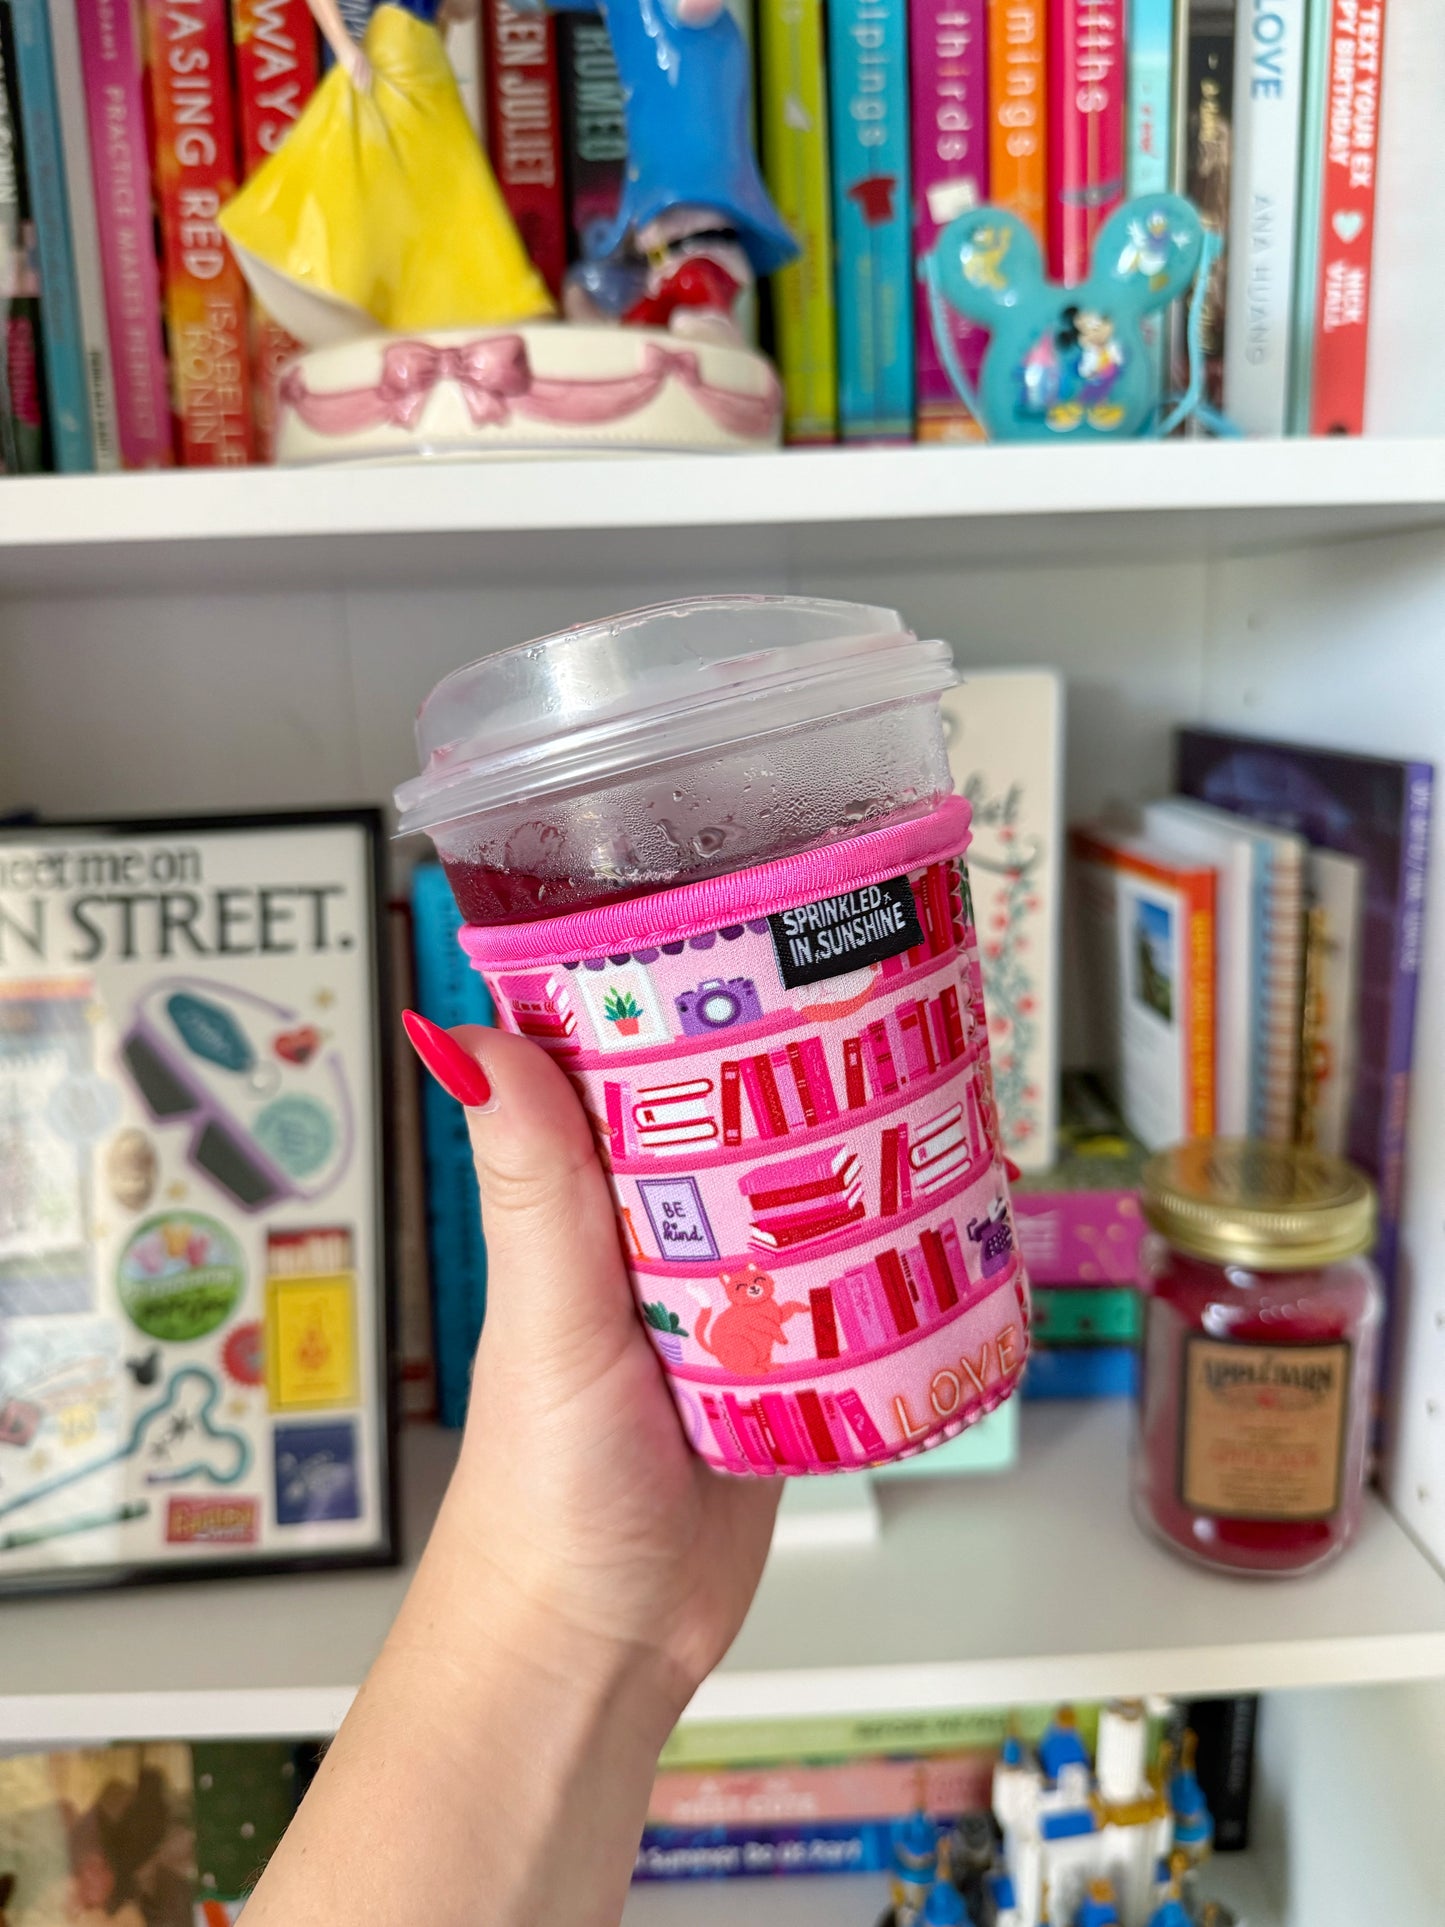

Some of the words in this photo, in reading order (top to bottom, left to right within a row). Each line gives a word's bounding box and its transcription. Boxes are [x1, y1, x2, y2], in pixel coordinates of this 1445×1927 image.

[166, 0, 217, 167] ASING
[849, 0, 890, 147] lpings
[1356, 5, 1381, 75] TEXT
[935, 10, 973, 161] thirds
[1329, 36, 1356, 167] BIRTHDAY
[1352, 77, 1379, 160] YOUR
[103, 86, 136, 219] PRACTICE
[500, 76, 555, 188] JULIET
[1349, 160, 1374, 189] EX
[178, 186, 224, 281] RED
[1254, 195, 1276, 260] ANA
[1245, 266, 1275, 366] HUANG
[182, 328, 217, 445] RONIN
[79, 847, 145, 886] me
[150, 844, 202, 883] on
[67, 884, 355, 963] STREET.
[782, 885, 881, 936] SPRINKLED
[789, 936, 813, 967] IN
[817, 902, 906, 959] SUNSHINE
[662, 1202, 686, 1218] BE
[662, 1220, 704, 1242] kind
[892, 1325, 1019, 1439] LOVE
